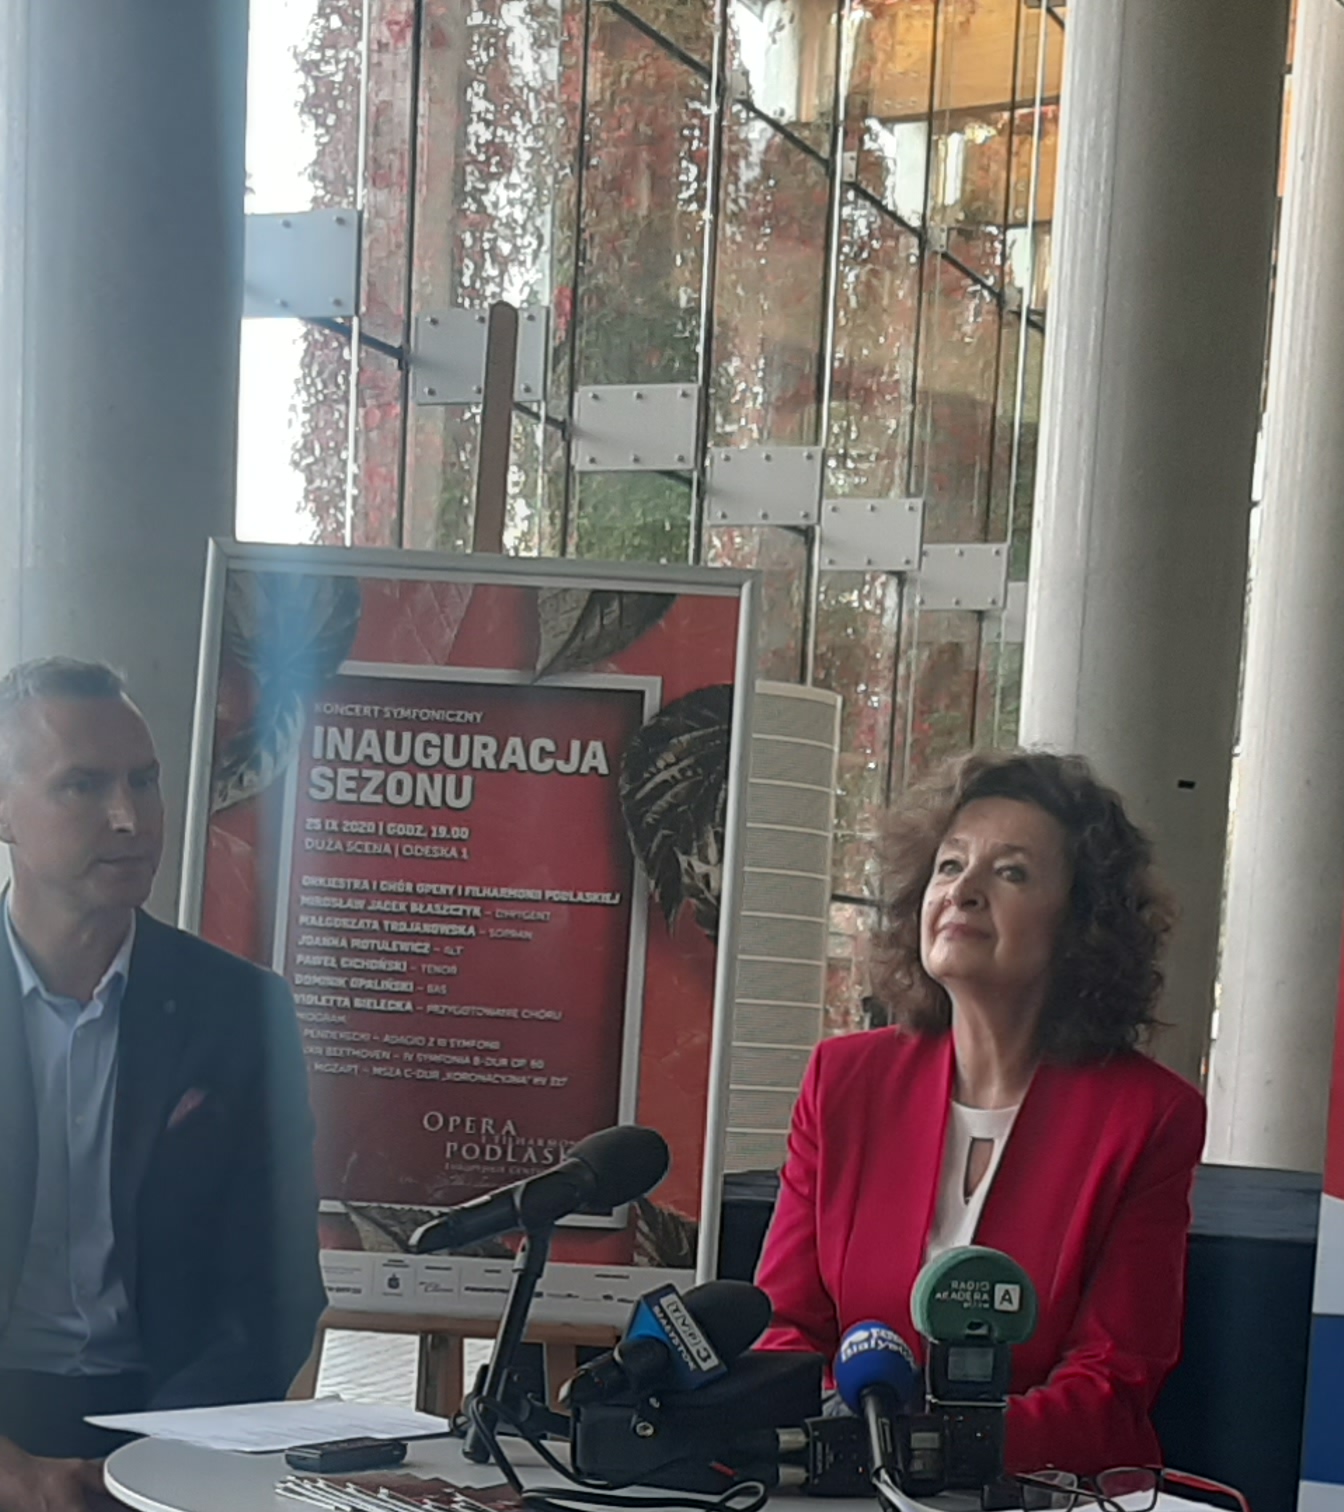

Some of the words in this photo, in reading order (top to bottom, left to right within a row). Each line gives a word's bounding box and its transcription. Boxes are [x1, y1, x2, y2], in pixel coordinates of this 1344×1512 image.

[314, 702, 379, 719] KONCERT
[383, 706, 484, 724] SYMFONICZNY
[311, 725, 610, 776] INAUGURACJA
[307, 765, 475, 810] SEZONU
[305, 818, 321, 831] 25
[325, 819, 338, 832] IX
[342, 820, 376, 834] 2020
[431, 825, 470, 841] 19.00
[346, 841, 393, 856] SCENA
[402, 844, 458, 860] ODESKA
[461, 847, 469, 860] 1
[301, 875, 370, 892] ORKIESTRA
[380, 878, 413, 893] CHÓR
[416, 882, 456, 897] OPERY
[464, 886, 543, 901] FILHARMONII
[544, 890, 621, 905] PODLASKIEJ
[367, 899, 409, 914] JACEK
[297, 934, 348, 949] JOANNA
[295, 953, 339, 969] PAWEŁ
